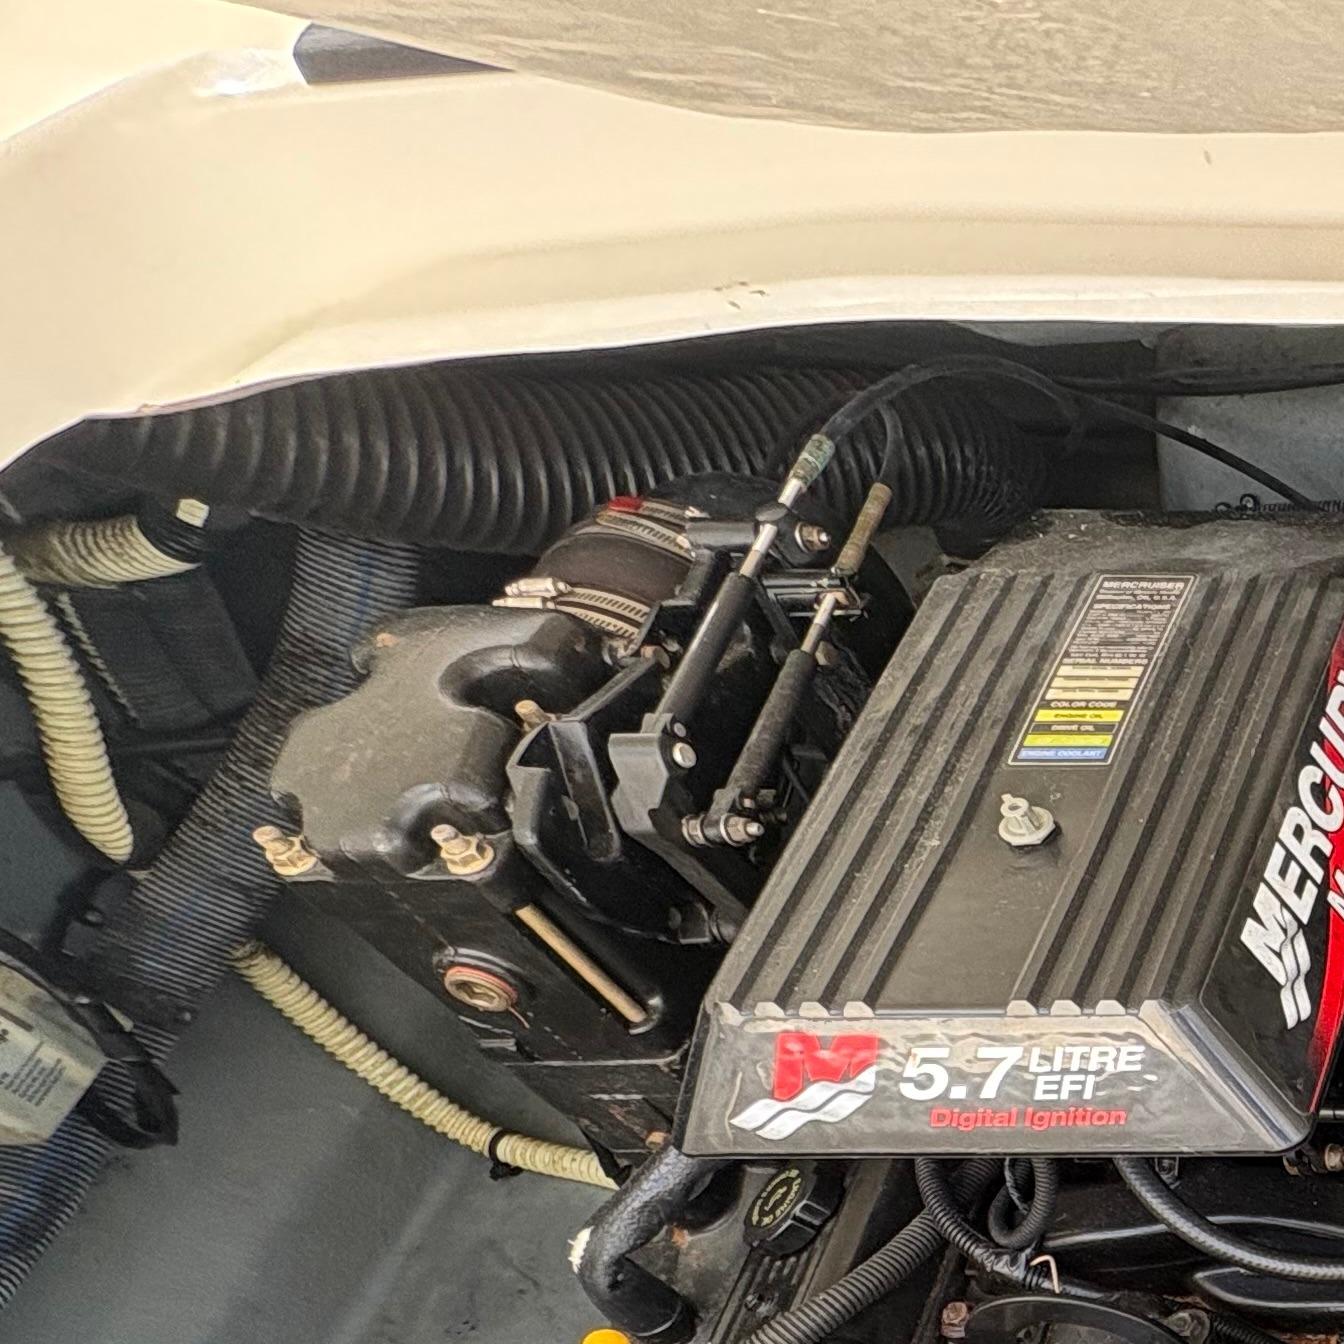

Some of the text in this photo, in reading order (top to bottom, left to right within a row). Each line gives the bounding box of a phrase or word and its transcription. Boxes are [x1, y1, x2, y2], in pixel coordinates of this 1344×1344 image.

[899, 1045, 1145, 1102] 5.7 LITRE
[1034, 1074, 1096, 1101] EFI
[930, 1106, 1127, 1132] Digital Ignition
